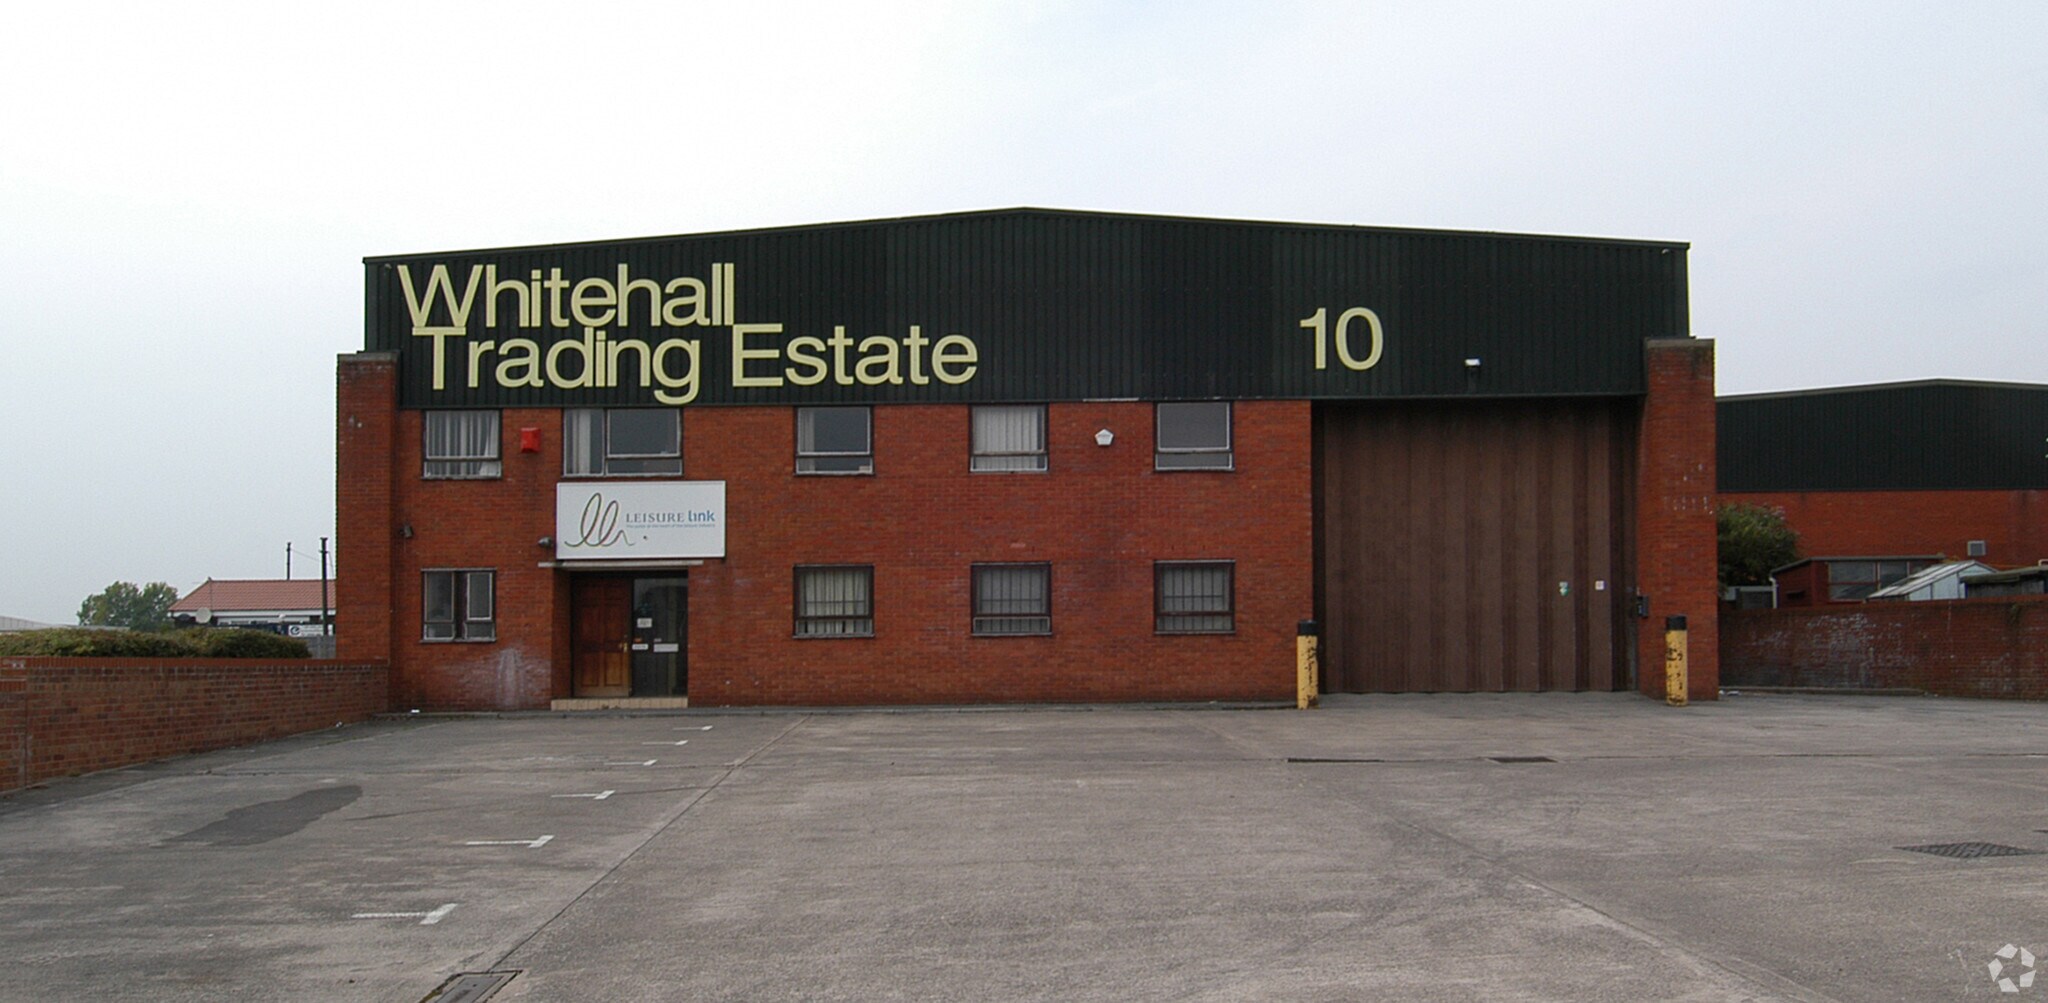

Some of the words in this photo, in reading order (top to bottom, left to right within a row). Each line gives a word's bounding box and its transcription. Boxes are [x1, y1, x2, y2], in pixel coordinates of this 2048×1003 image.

[397, 262, 735, 328] Whitehall
[411, 326, 701, 405] Trading
[732, 323, 979, 387] Estate
[1299, 307, 1384, 371] 10
[626, 512, 685, 523] LEISURE
[687, 509, 715, 522] link
